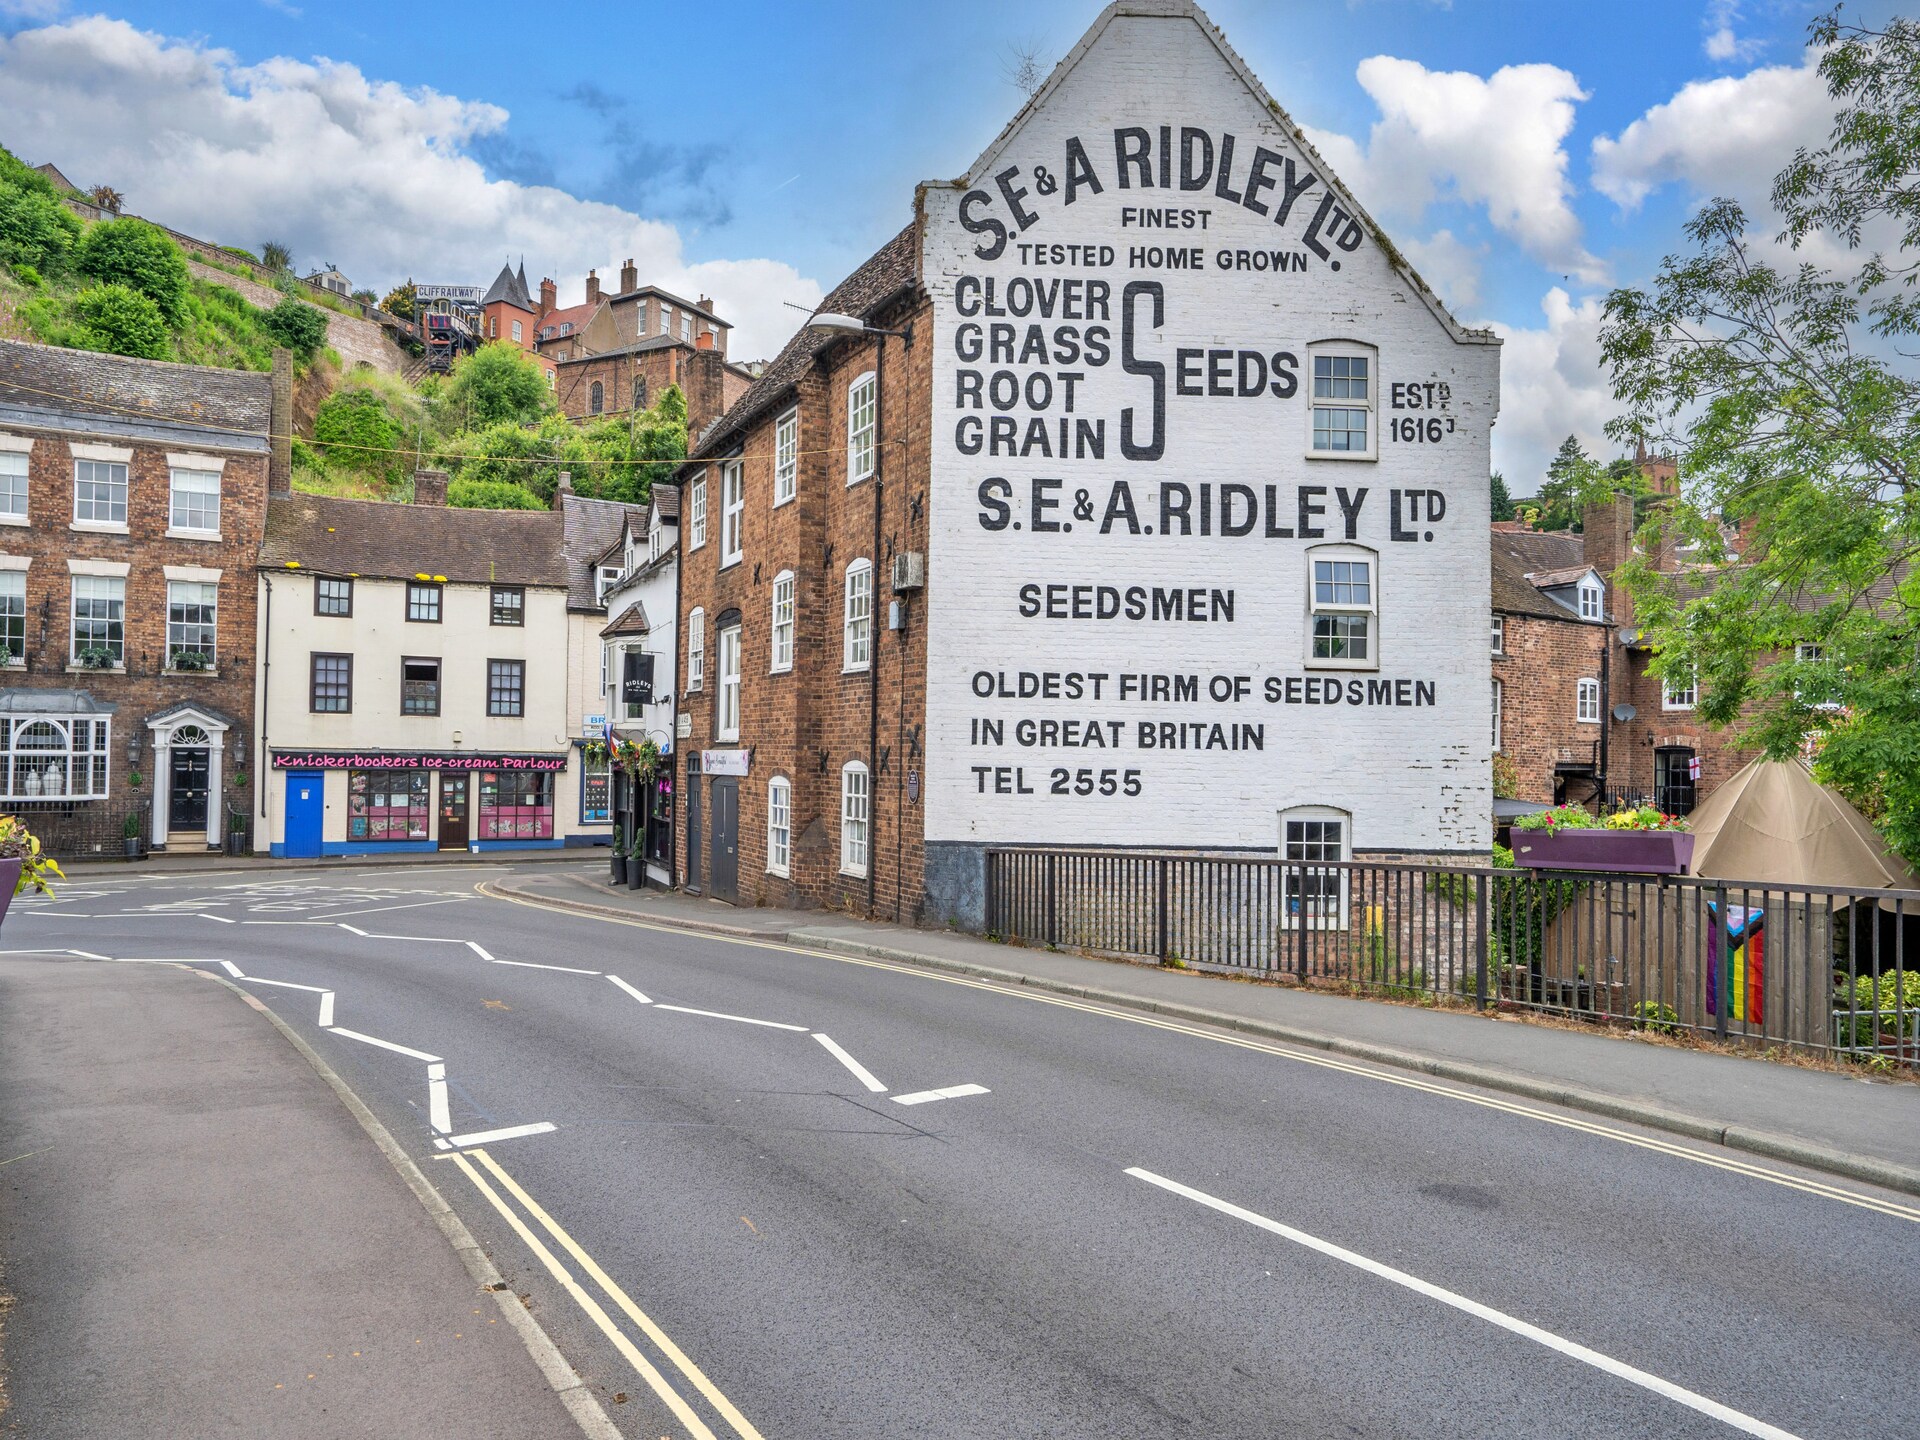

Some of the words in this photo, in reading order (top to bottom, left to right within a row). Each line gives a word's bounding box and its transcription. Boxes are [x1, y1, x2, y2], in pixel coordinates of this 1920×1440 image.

[1113, 126, 1319, 228] RIDLEY
[1121, 207, 1212, 230] FINEST
[1017, 243, 1115, 267] TESTED
[1129, 246, 1204, 270] HOME
[1216, 249, 1307, 273] GROWN
[418, 286, 440, 297] CLIFF
[440, 287, 475, 298] RAILWAY
[954, 275, 1111, 321] CLOVER
[955, 322, 1111, 367] GRASS
[956, 369, 1085, 413] ROOT
[955, 415, 1105, 460] GRAIN
[1159, 481, 1369, 540] RIDLEY
[1019, 583, 1235, 623] SEEDSMEN
[625, 679, 652, 689] RIDLEYS
[971, 671, 1109, 700] OLDEST
[1119, 673, 1199, 702] FIRM
[1209, 675, 1251, 703] OF
[1264, 676, 1436, 707] SEEDSMEN
[971, 718, 1004, 746] IN
[1015, 719, 1126, 748] GREAT
[1138, 721, 1264, 751] BRITAIN
[276, 753, 419, 768] Knickerbockers
[421, 756, 500, 769] Ice-cream
[502, 757, 565, 769] Parlour
[971, 766, 1034, 794] TEL
[1050, 768, 1142, 797] 2555
